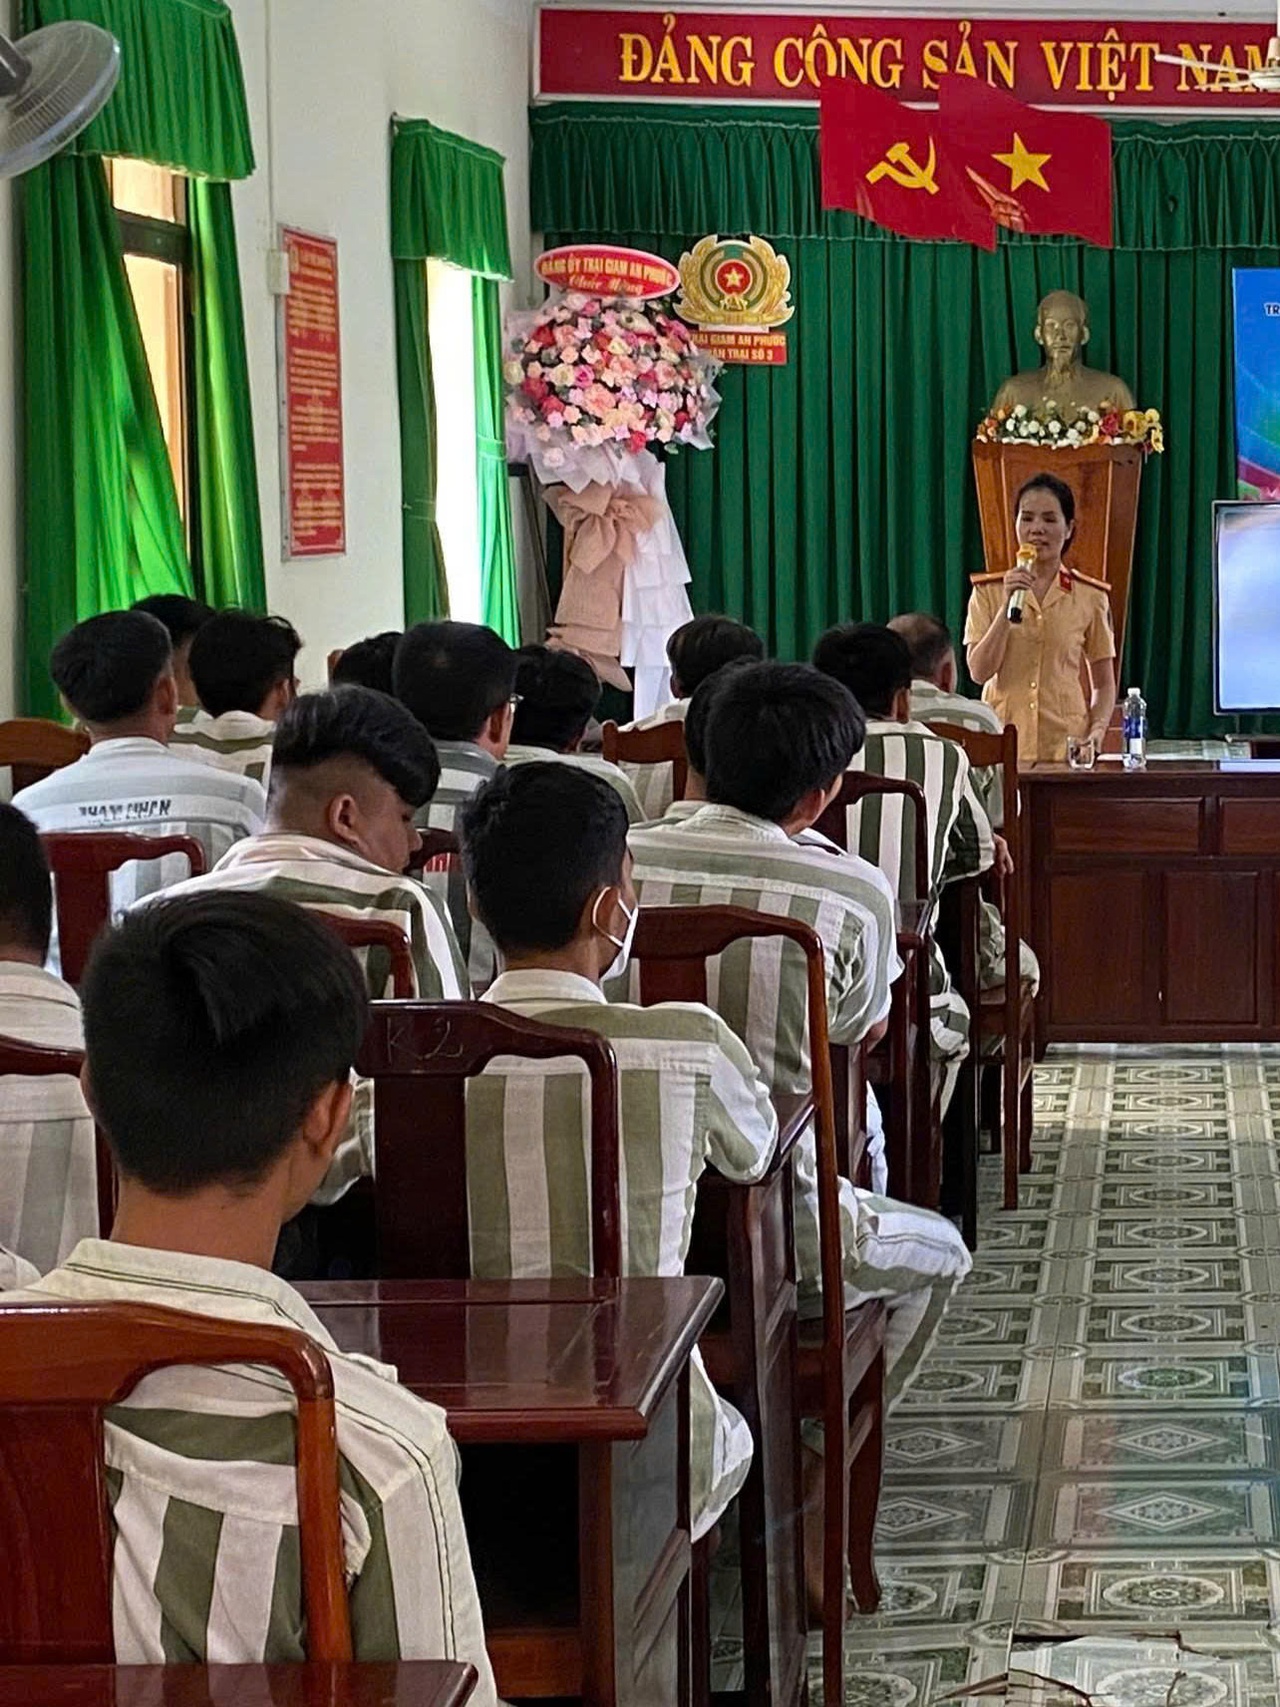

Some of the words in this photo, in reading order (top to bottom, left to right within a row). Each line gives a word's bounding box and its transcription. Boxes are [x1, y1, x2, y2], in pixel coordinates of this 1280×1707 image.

[619, 11, 755, 87] ĐẢNG
[774, 24, 904, 88] CÔNG
[923, 20, 1018, 89] SẢN
[1040, 27, 1161, 102] VIỆT
